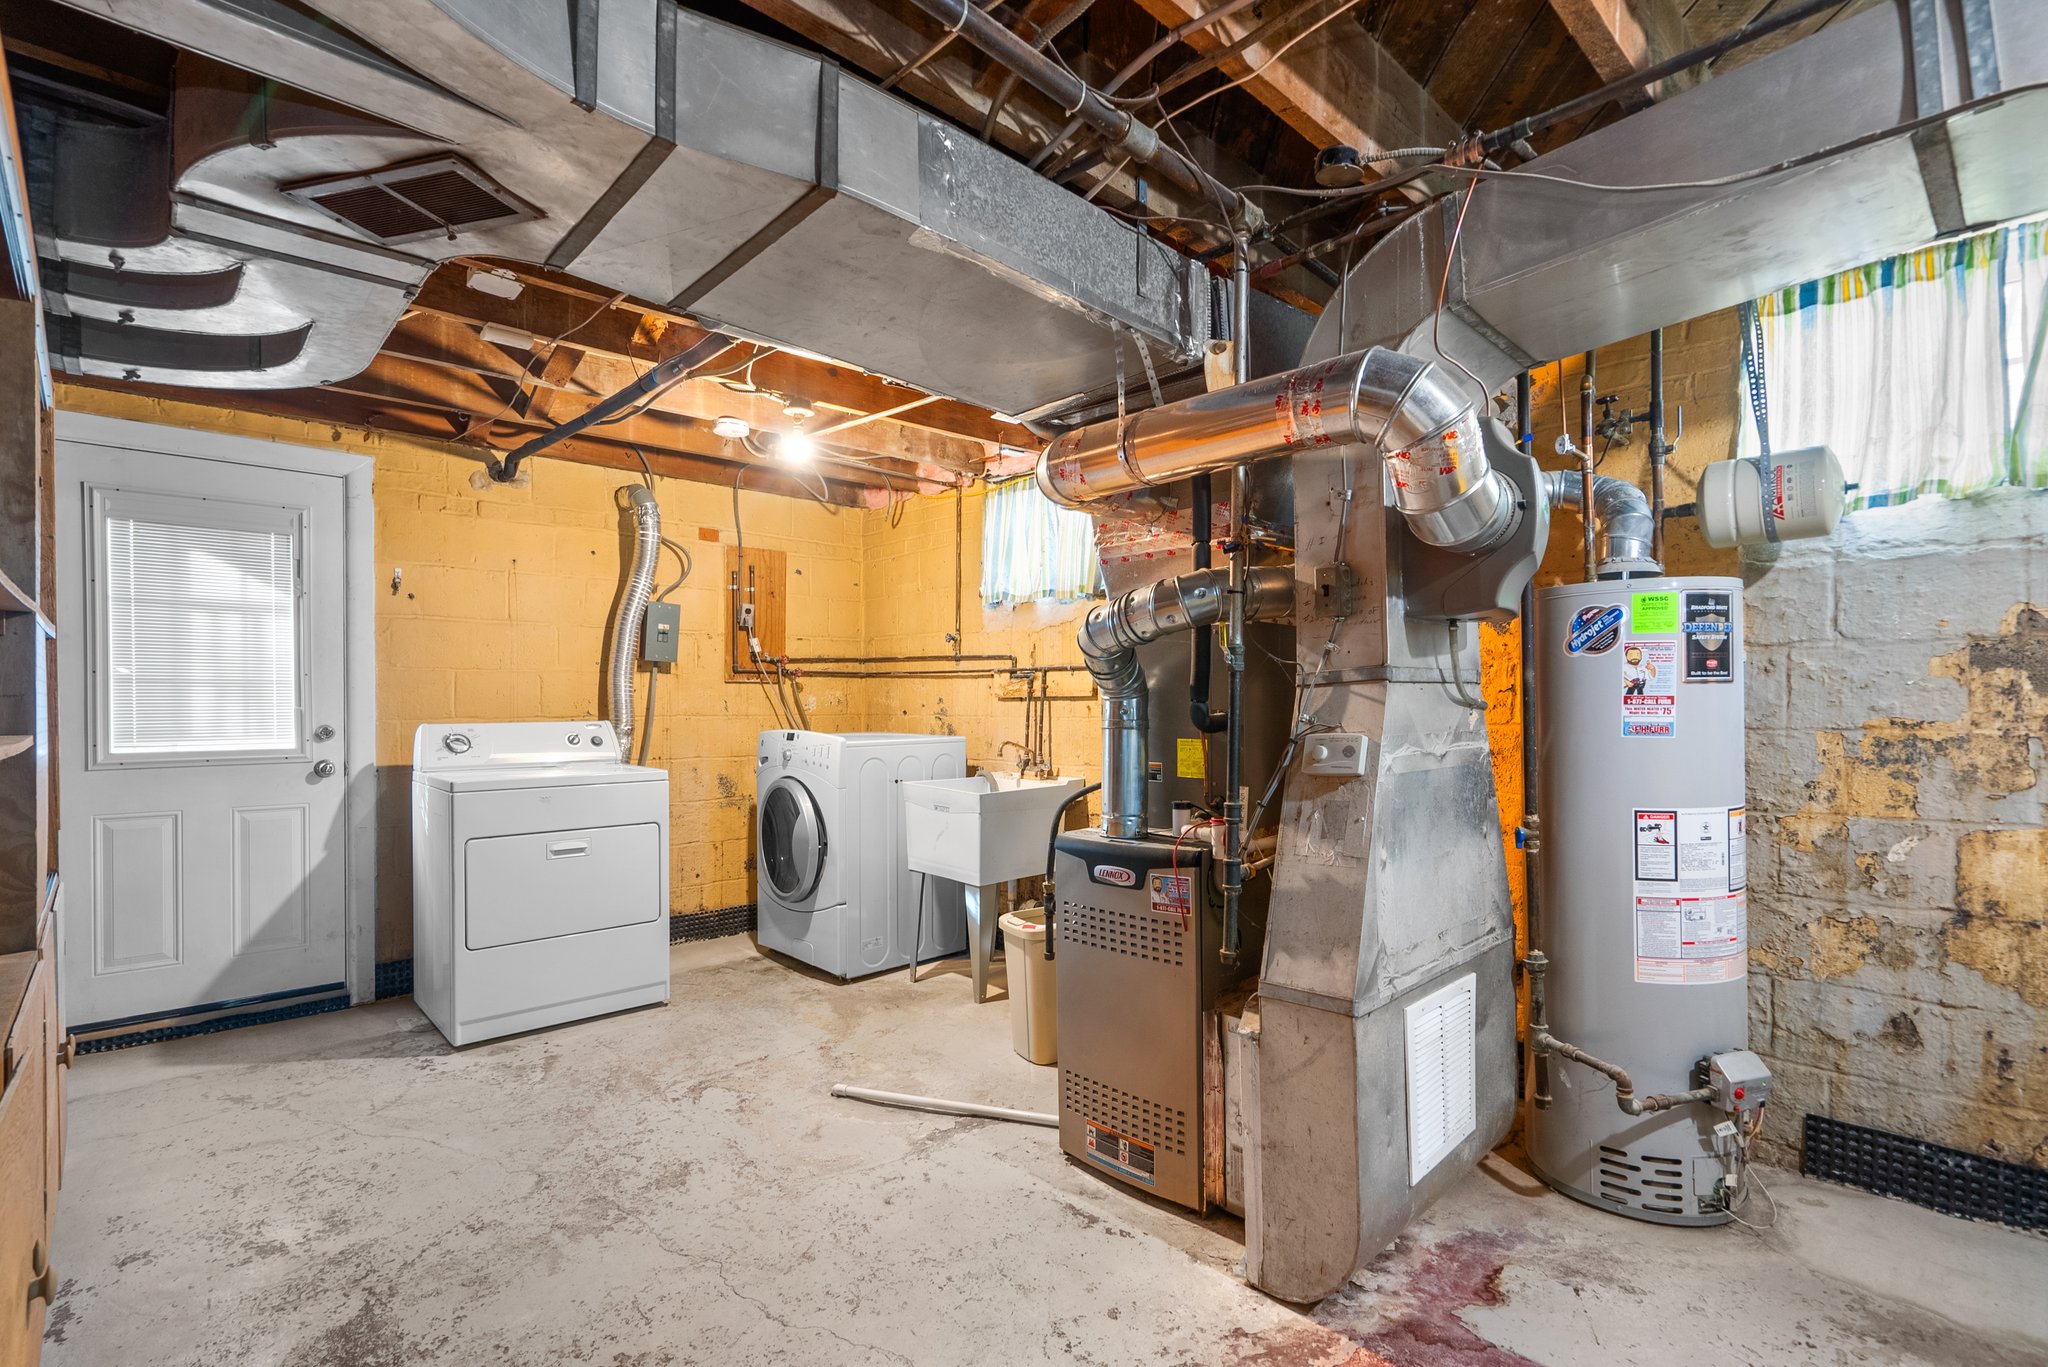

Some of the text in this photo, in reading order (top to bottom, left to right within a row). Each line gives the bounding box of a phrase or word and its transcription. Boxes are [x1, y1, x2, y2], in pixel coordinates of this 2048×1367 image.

[1683, 622, 1732, 632] DEFENDER
[1571, 620, 1604, 649] Hydrojet
[1099, 869, 1123, 880] LENNOX
